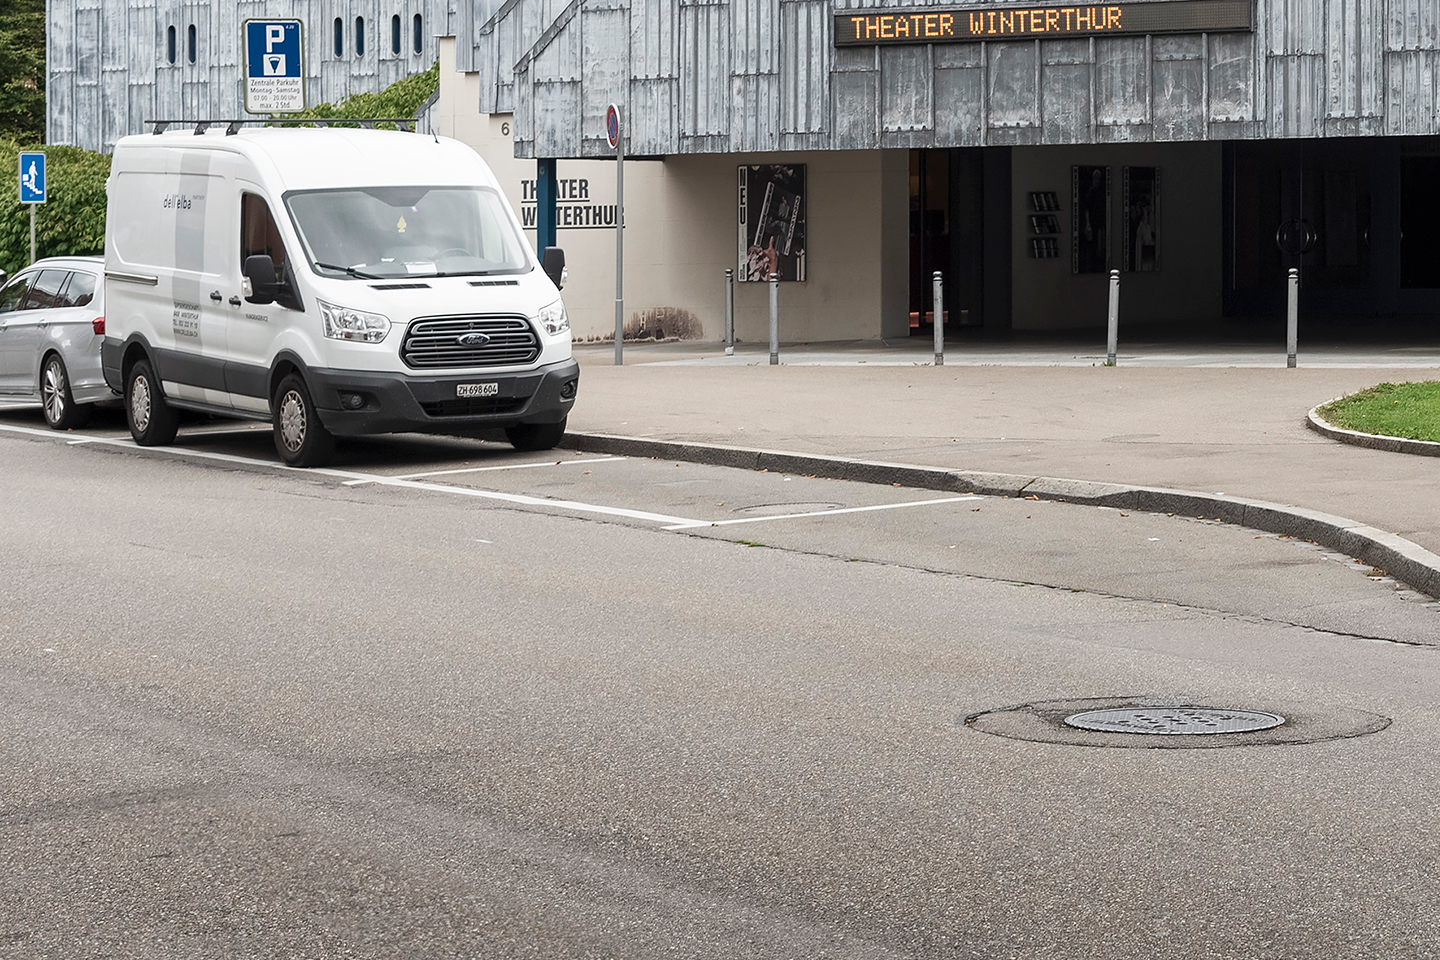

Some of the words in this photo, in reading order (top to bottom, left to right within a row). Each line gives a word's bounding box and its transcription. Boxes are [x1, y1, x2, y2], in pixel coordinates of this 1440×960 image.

[851, 14, 954, 39] THEATER
[969, 6, 1122, 35] WINTERTHUR
[266, 25, 285, 53] P
[250, 79, 275, 87] Zentrale
[501, 122, 510, 136] 6
[466, 335, 484, 344] Ford
[469, 385, 482, 395] 698
[484, 385, 497, 394] 604
